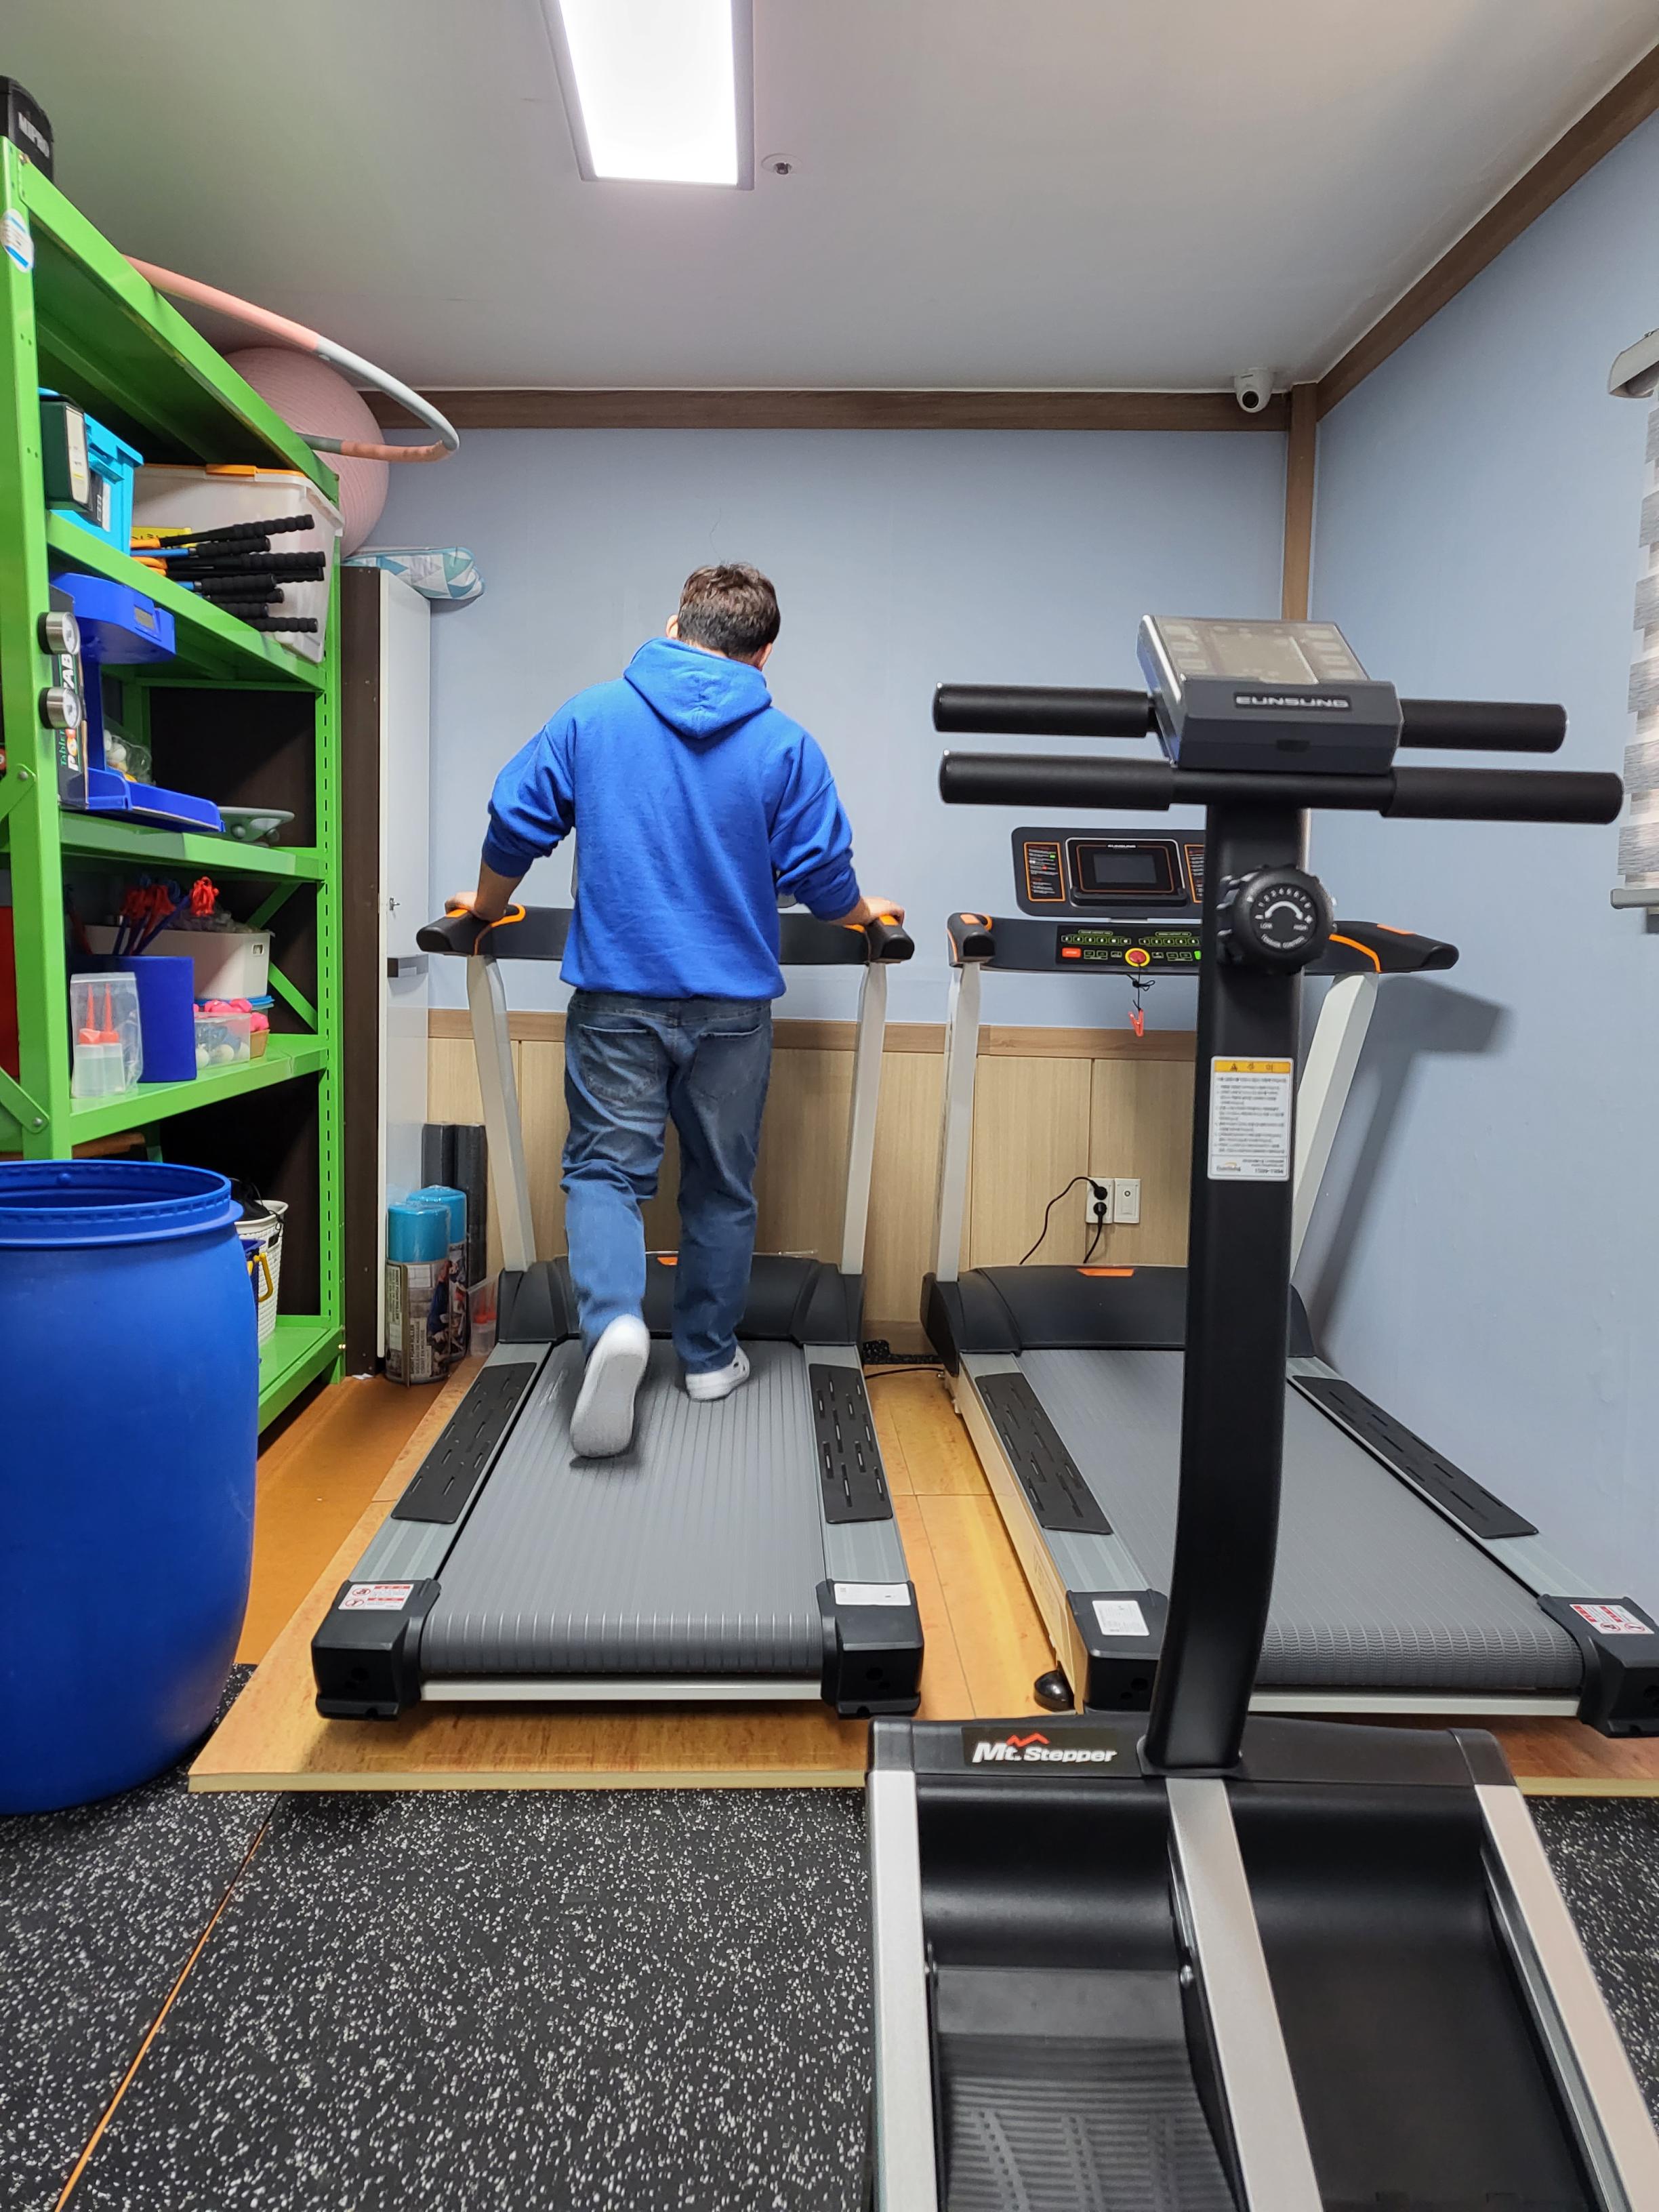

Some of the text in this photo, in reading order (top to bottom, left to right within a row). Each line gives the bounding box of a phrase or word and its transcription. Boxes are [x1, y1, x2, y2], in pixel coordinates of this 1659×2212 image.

[1236, 696, 1349, 708] EUNSUNG
[972, 1742, 1118, 1763] Mt. Stepper
